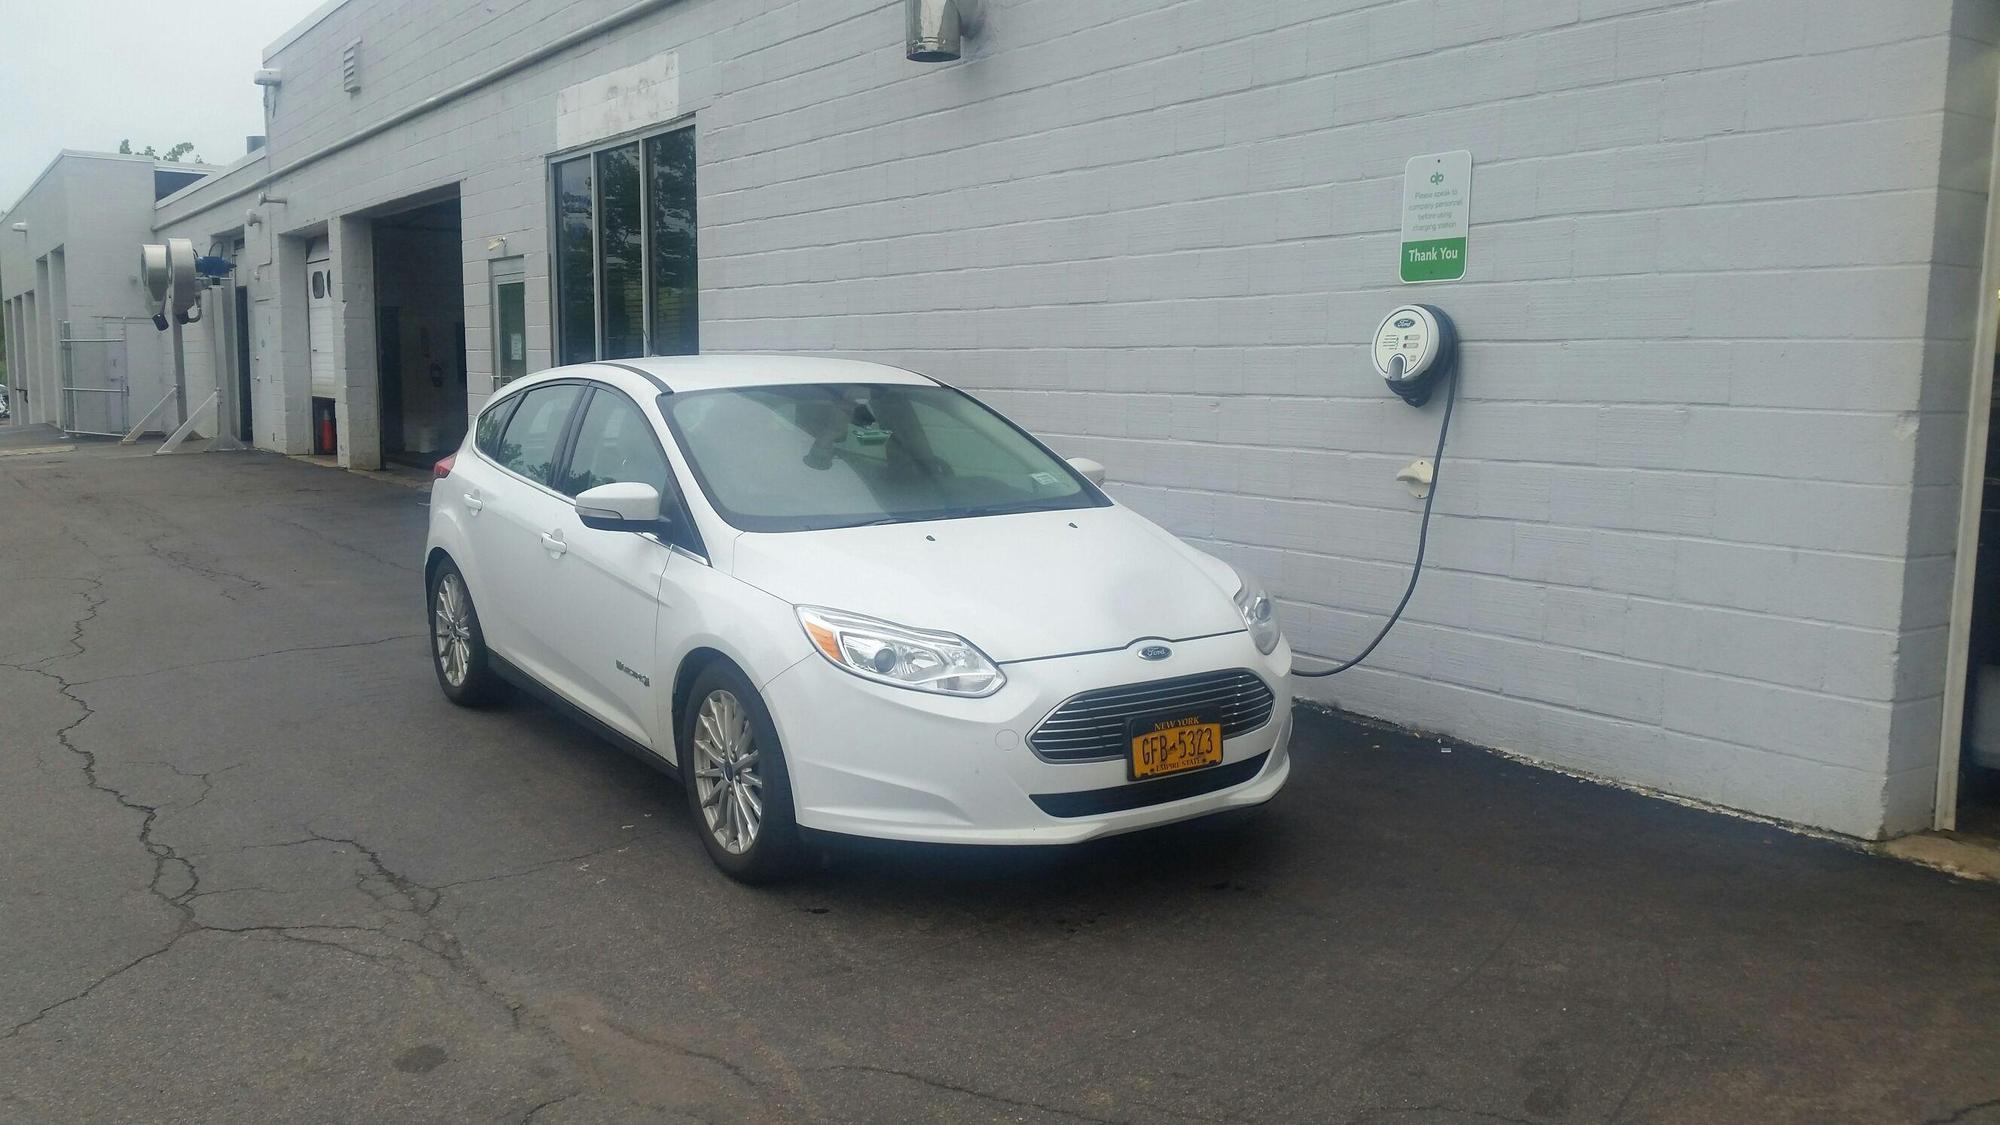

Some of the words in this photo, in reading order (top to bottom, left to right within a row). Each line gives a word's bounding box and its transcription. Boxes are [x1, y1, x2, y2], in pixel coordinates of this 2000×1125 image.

[1408, 247, 1437, 262] Thank
[1440, 247, 1458, 260] You
[1154, 720, 1175, 731] NEW
[1177, 716, 1200, 728] YORK
